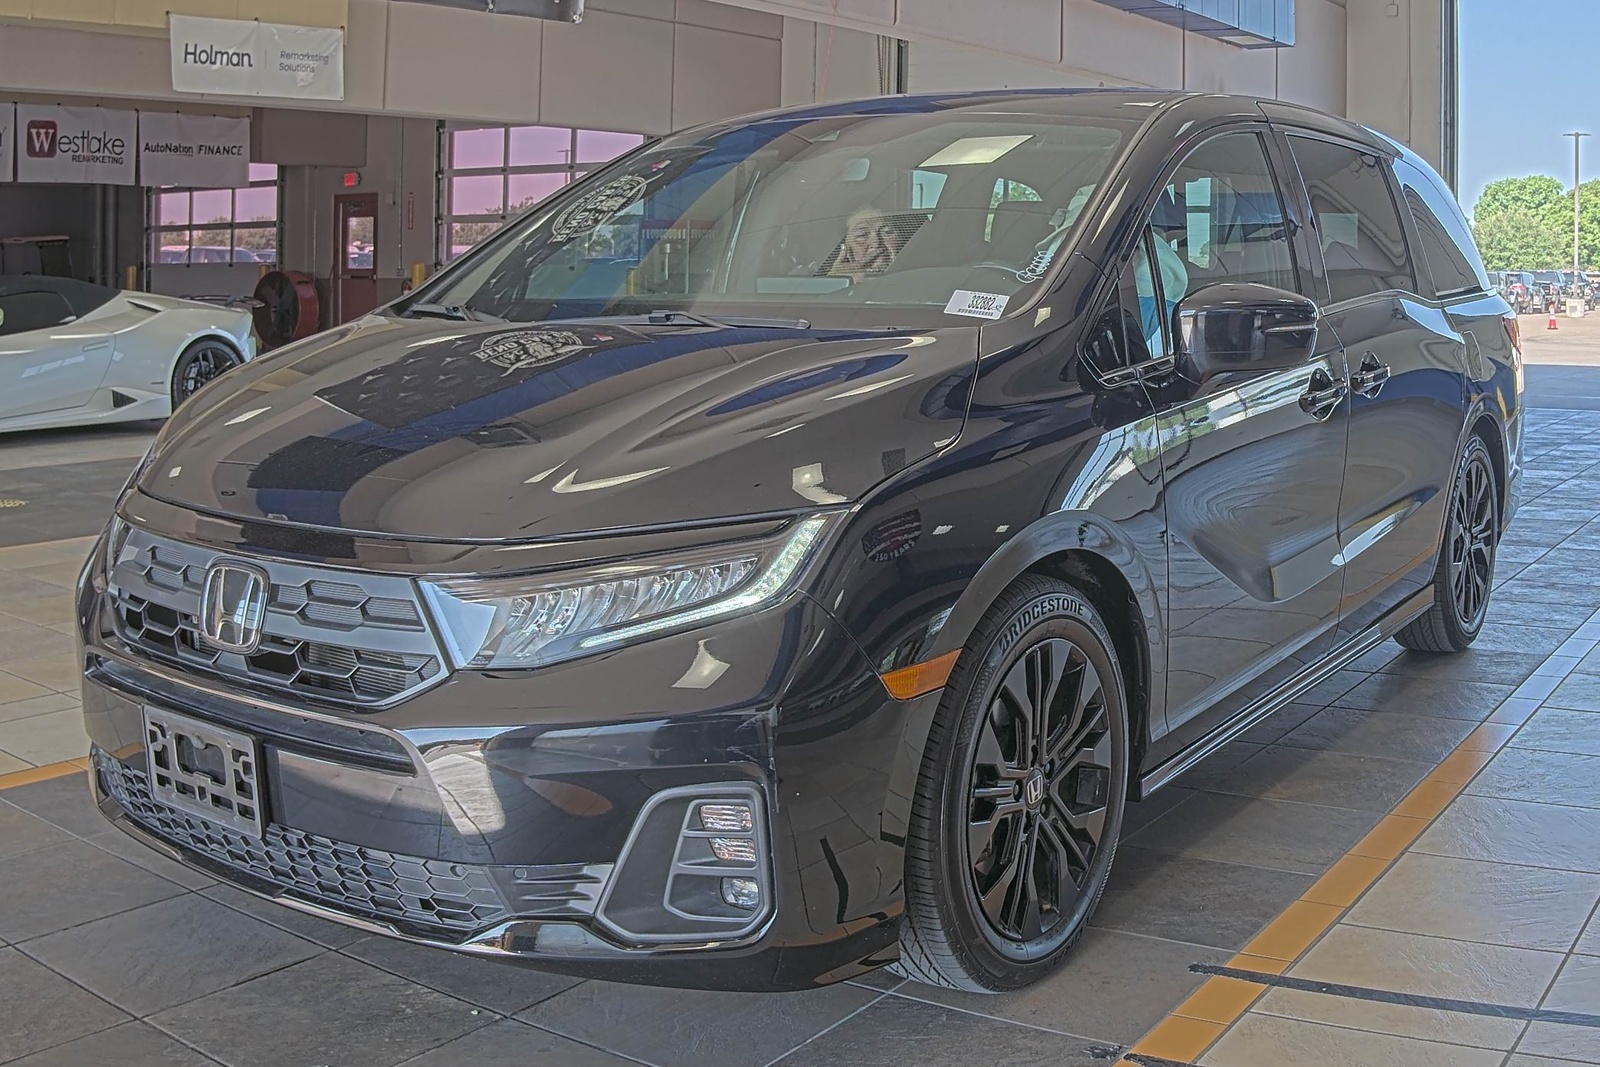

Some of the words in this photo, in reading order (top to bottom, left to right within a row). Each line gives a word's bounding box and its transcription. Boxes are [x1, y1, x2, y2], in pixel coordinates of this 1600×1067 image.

[183, 42, 253, 67] Holman
[279, 50, 330, 65] Remarketing
[279, 62, 315, 74] Solutions
[29, 128, 125, 156] Westlake
[143, 142, 194, 154] AutoNation
[198, 144, 243, 156] FINANCE
[71, 154, 124, 165] REMARKETING
[998, 597, 1084, 656] BRIDGESTONE
